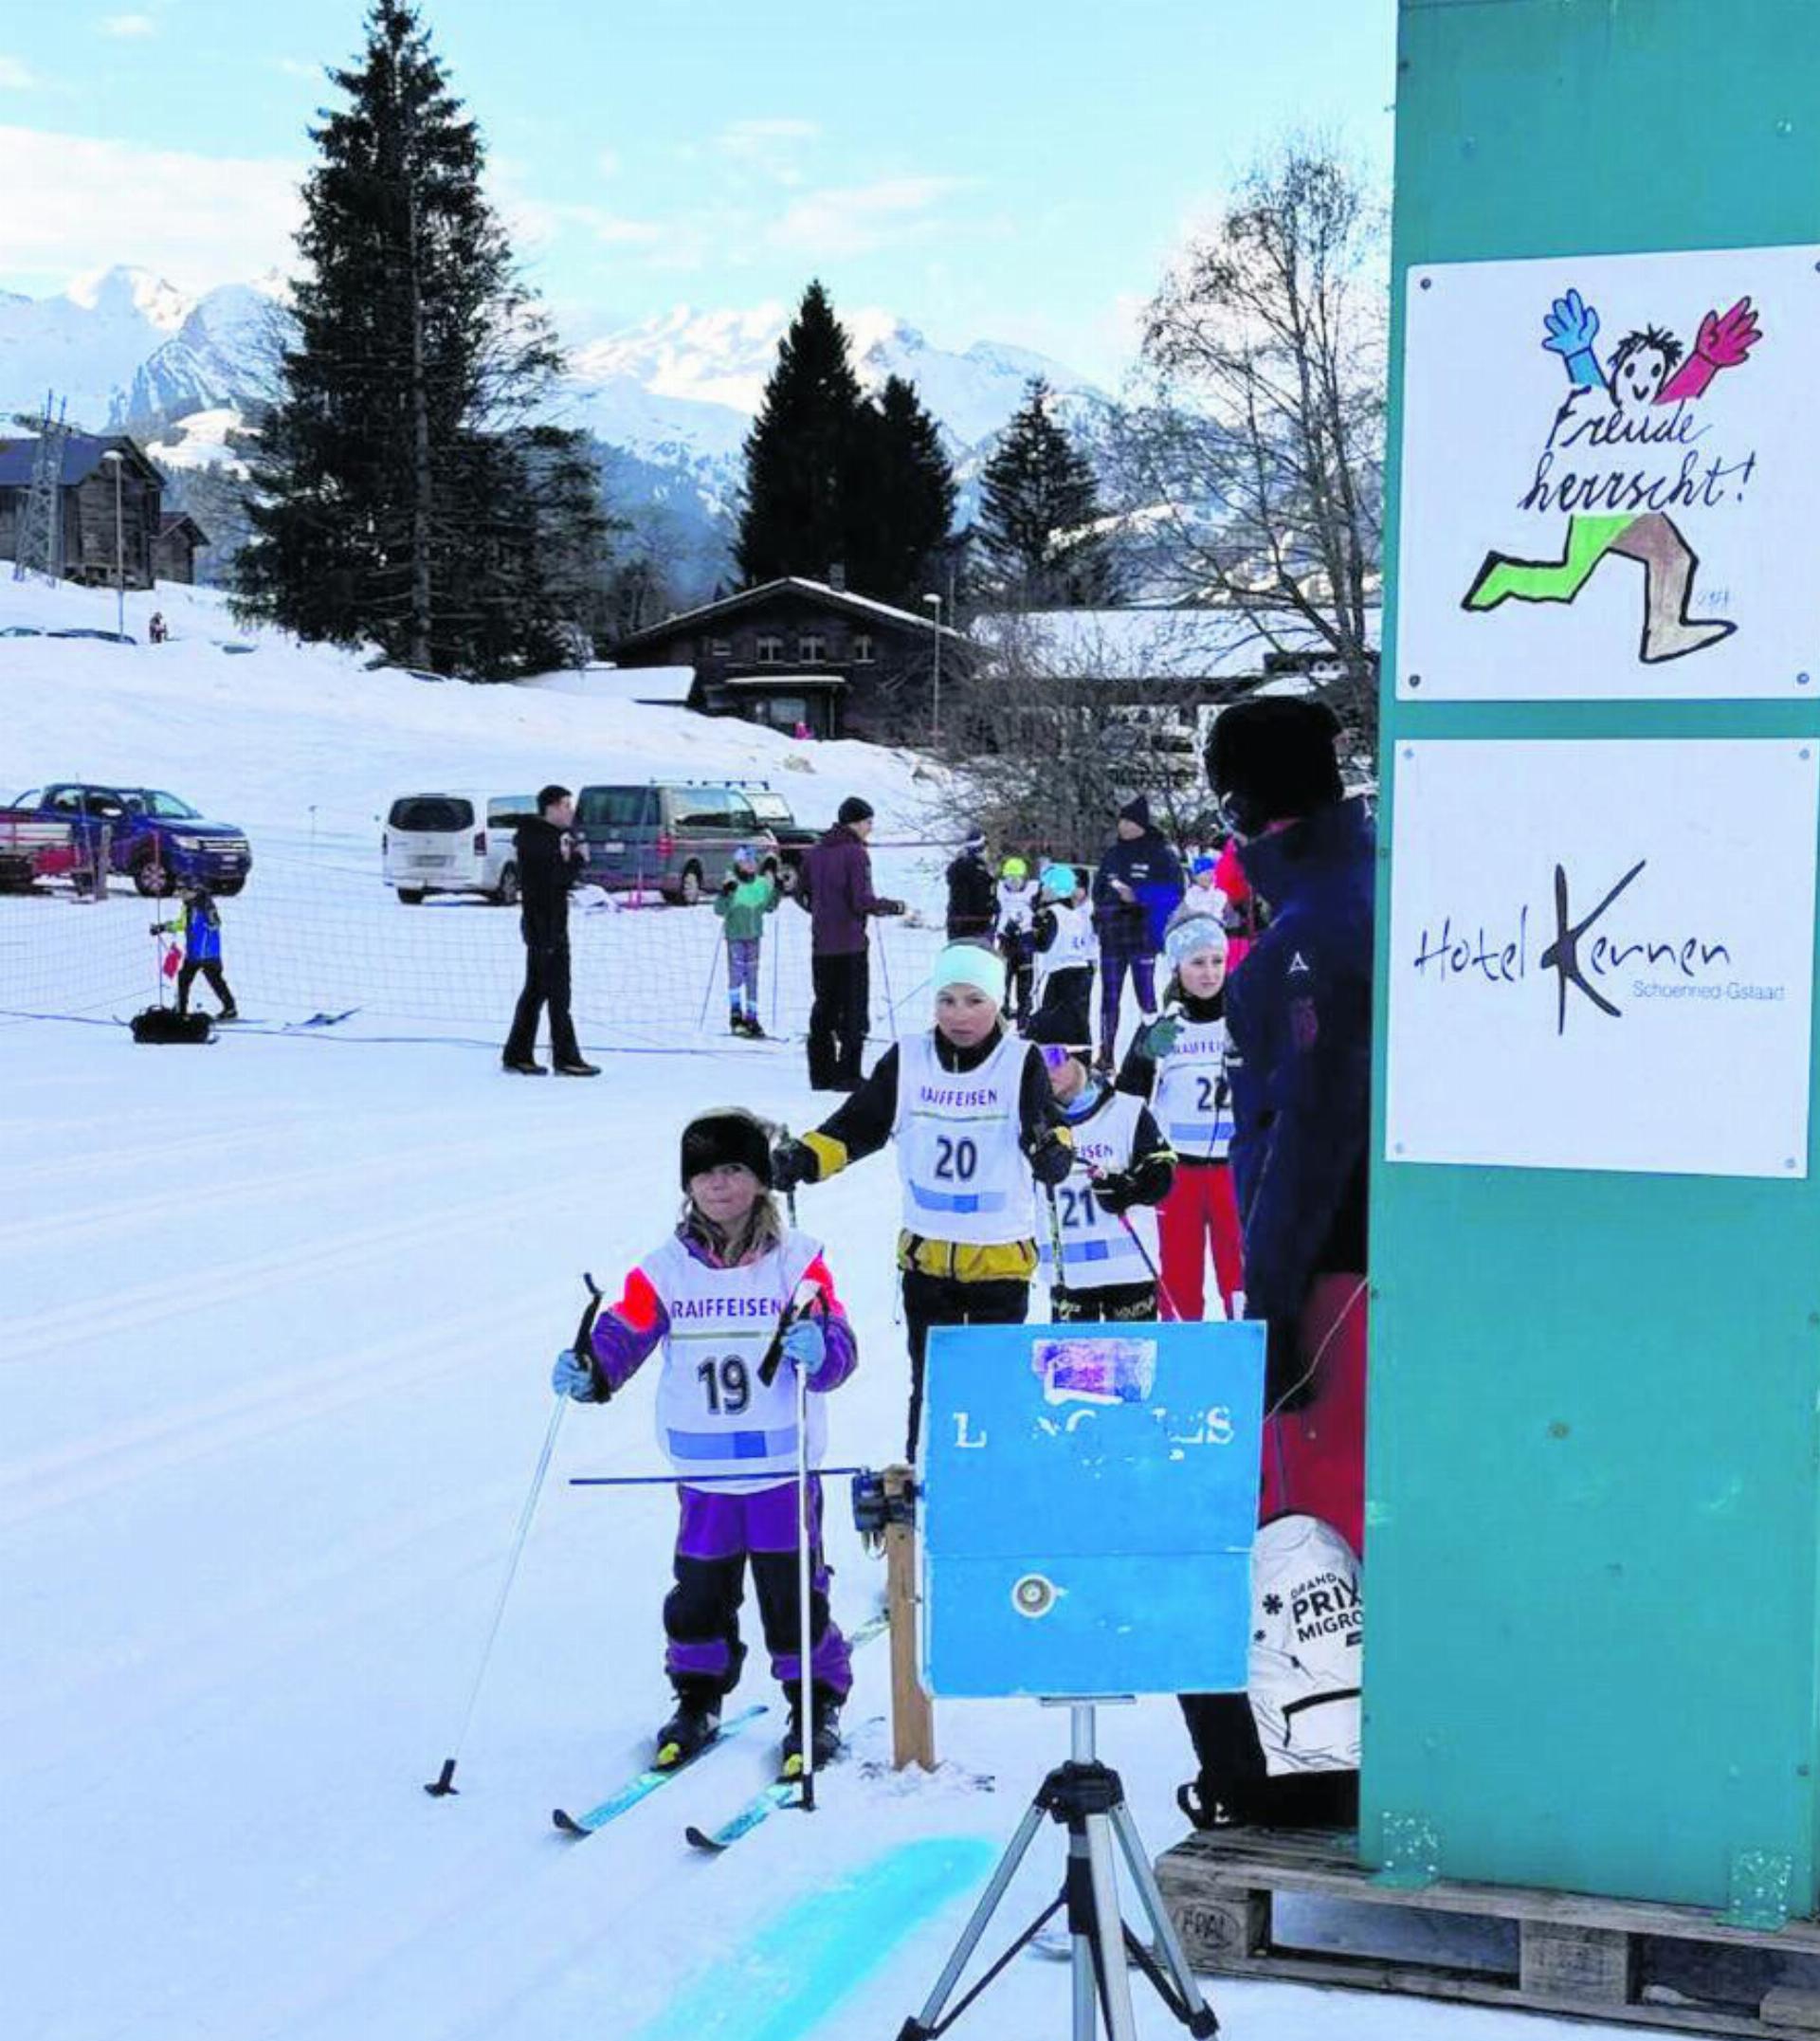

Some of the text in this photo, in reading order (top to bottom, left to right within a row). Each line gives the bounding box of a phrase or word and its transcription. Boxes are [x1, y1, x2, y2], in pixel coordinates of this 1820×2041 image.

[1545, 385, 1713, 449] Freude
[1518, 449, 1756, 513] herrscht!
[1414, 859, 1731, 1036] Hotel Kernen
[934, 1134, 978, 1182] 20
[1059, 1187, 1096, 1228] 21
[670, 1298, 782, 1319] RAIFFEISEN
[696, 1354, 751, 1415] 19
[1292, 1576, 1363, 1625] PRIX
[1297, 1610, 1364, 1642] MIGRO
